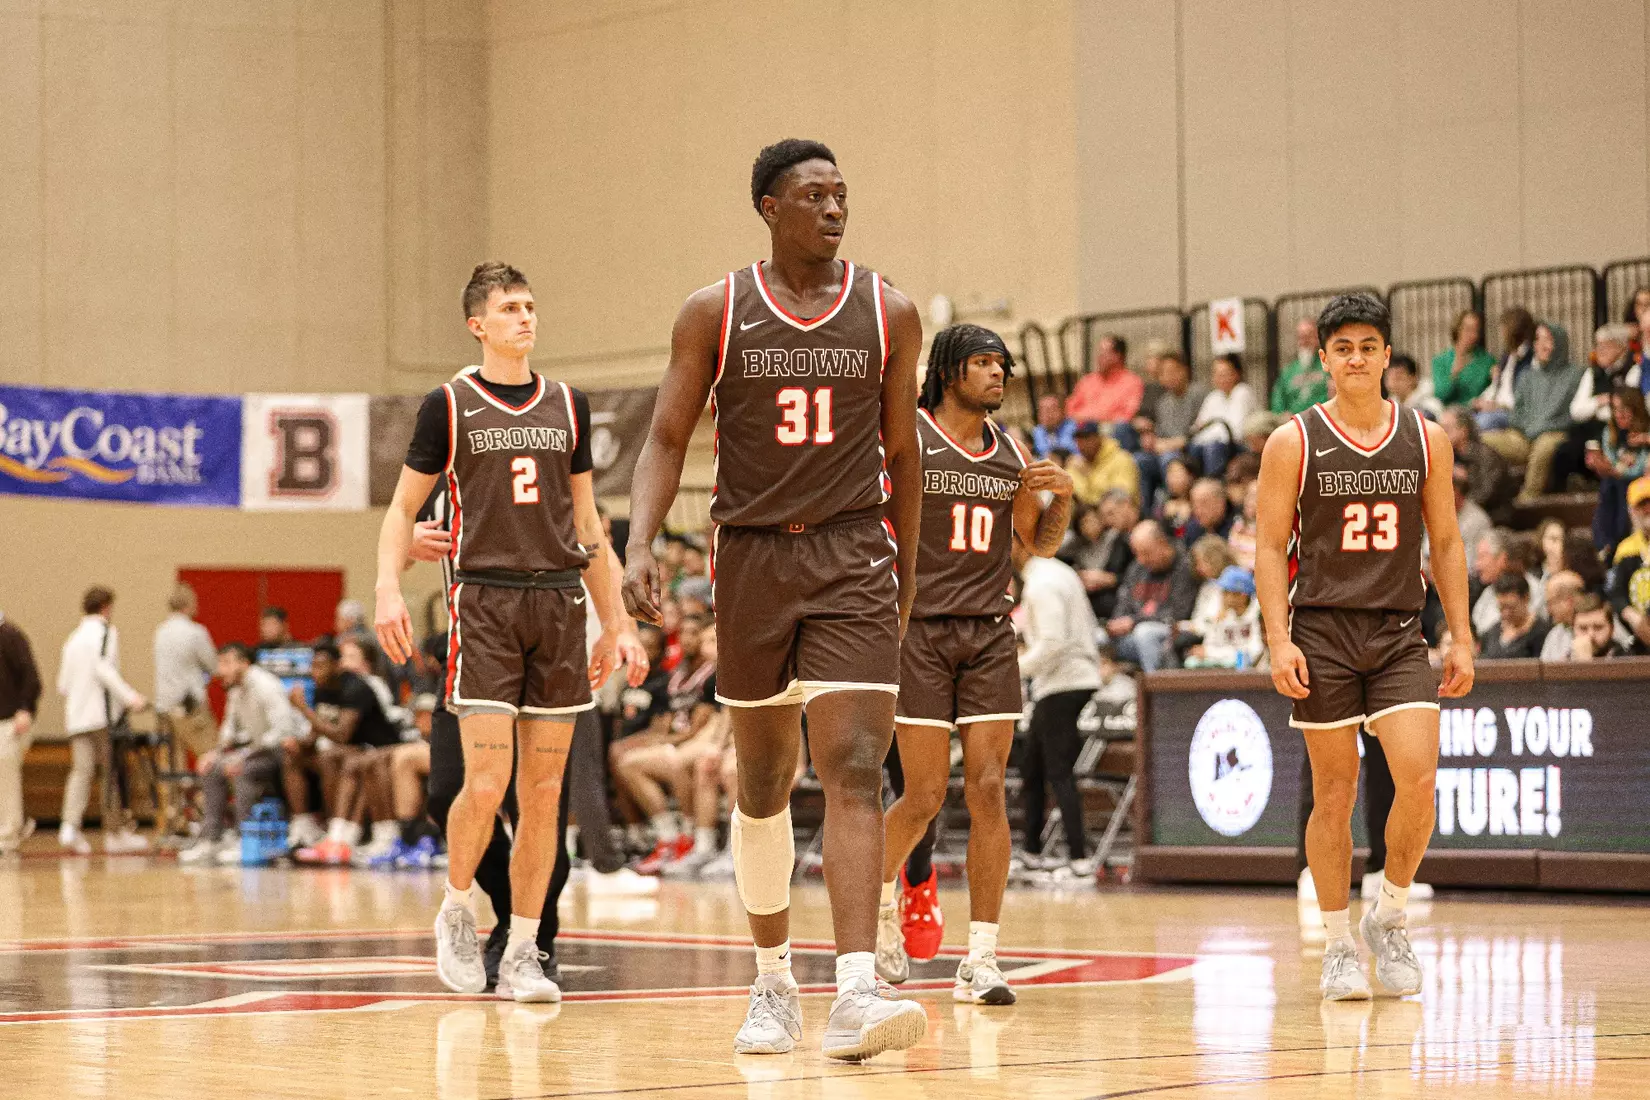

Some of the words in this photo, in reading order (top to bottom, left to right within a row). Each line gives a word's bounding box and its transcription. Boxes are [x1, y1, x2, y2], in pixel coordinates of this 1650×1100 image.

[1216, 308, 1236, 341] K
[742, 348, 868, 378] BROWN
[468, 426, 567, 454] BROWN
[775, 386, 835, 446] 31
[269, 409, 340, 496] B
[510, 455, 540, 505] 2
[924, 469, 1019, 501] BROWN
[1318, 469, 1419, 496] BROWN
[949, 502, 994, 554] 10
[1341, 501, 1400, 552] 23
[1439, 707, 1498, 757] ING
[1504, 705, 1594, 758] YOUR
[1435, 765, 1562, 838] TURE!
